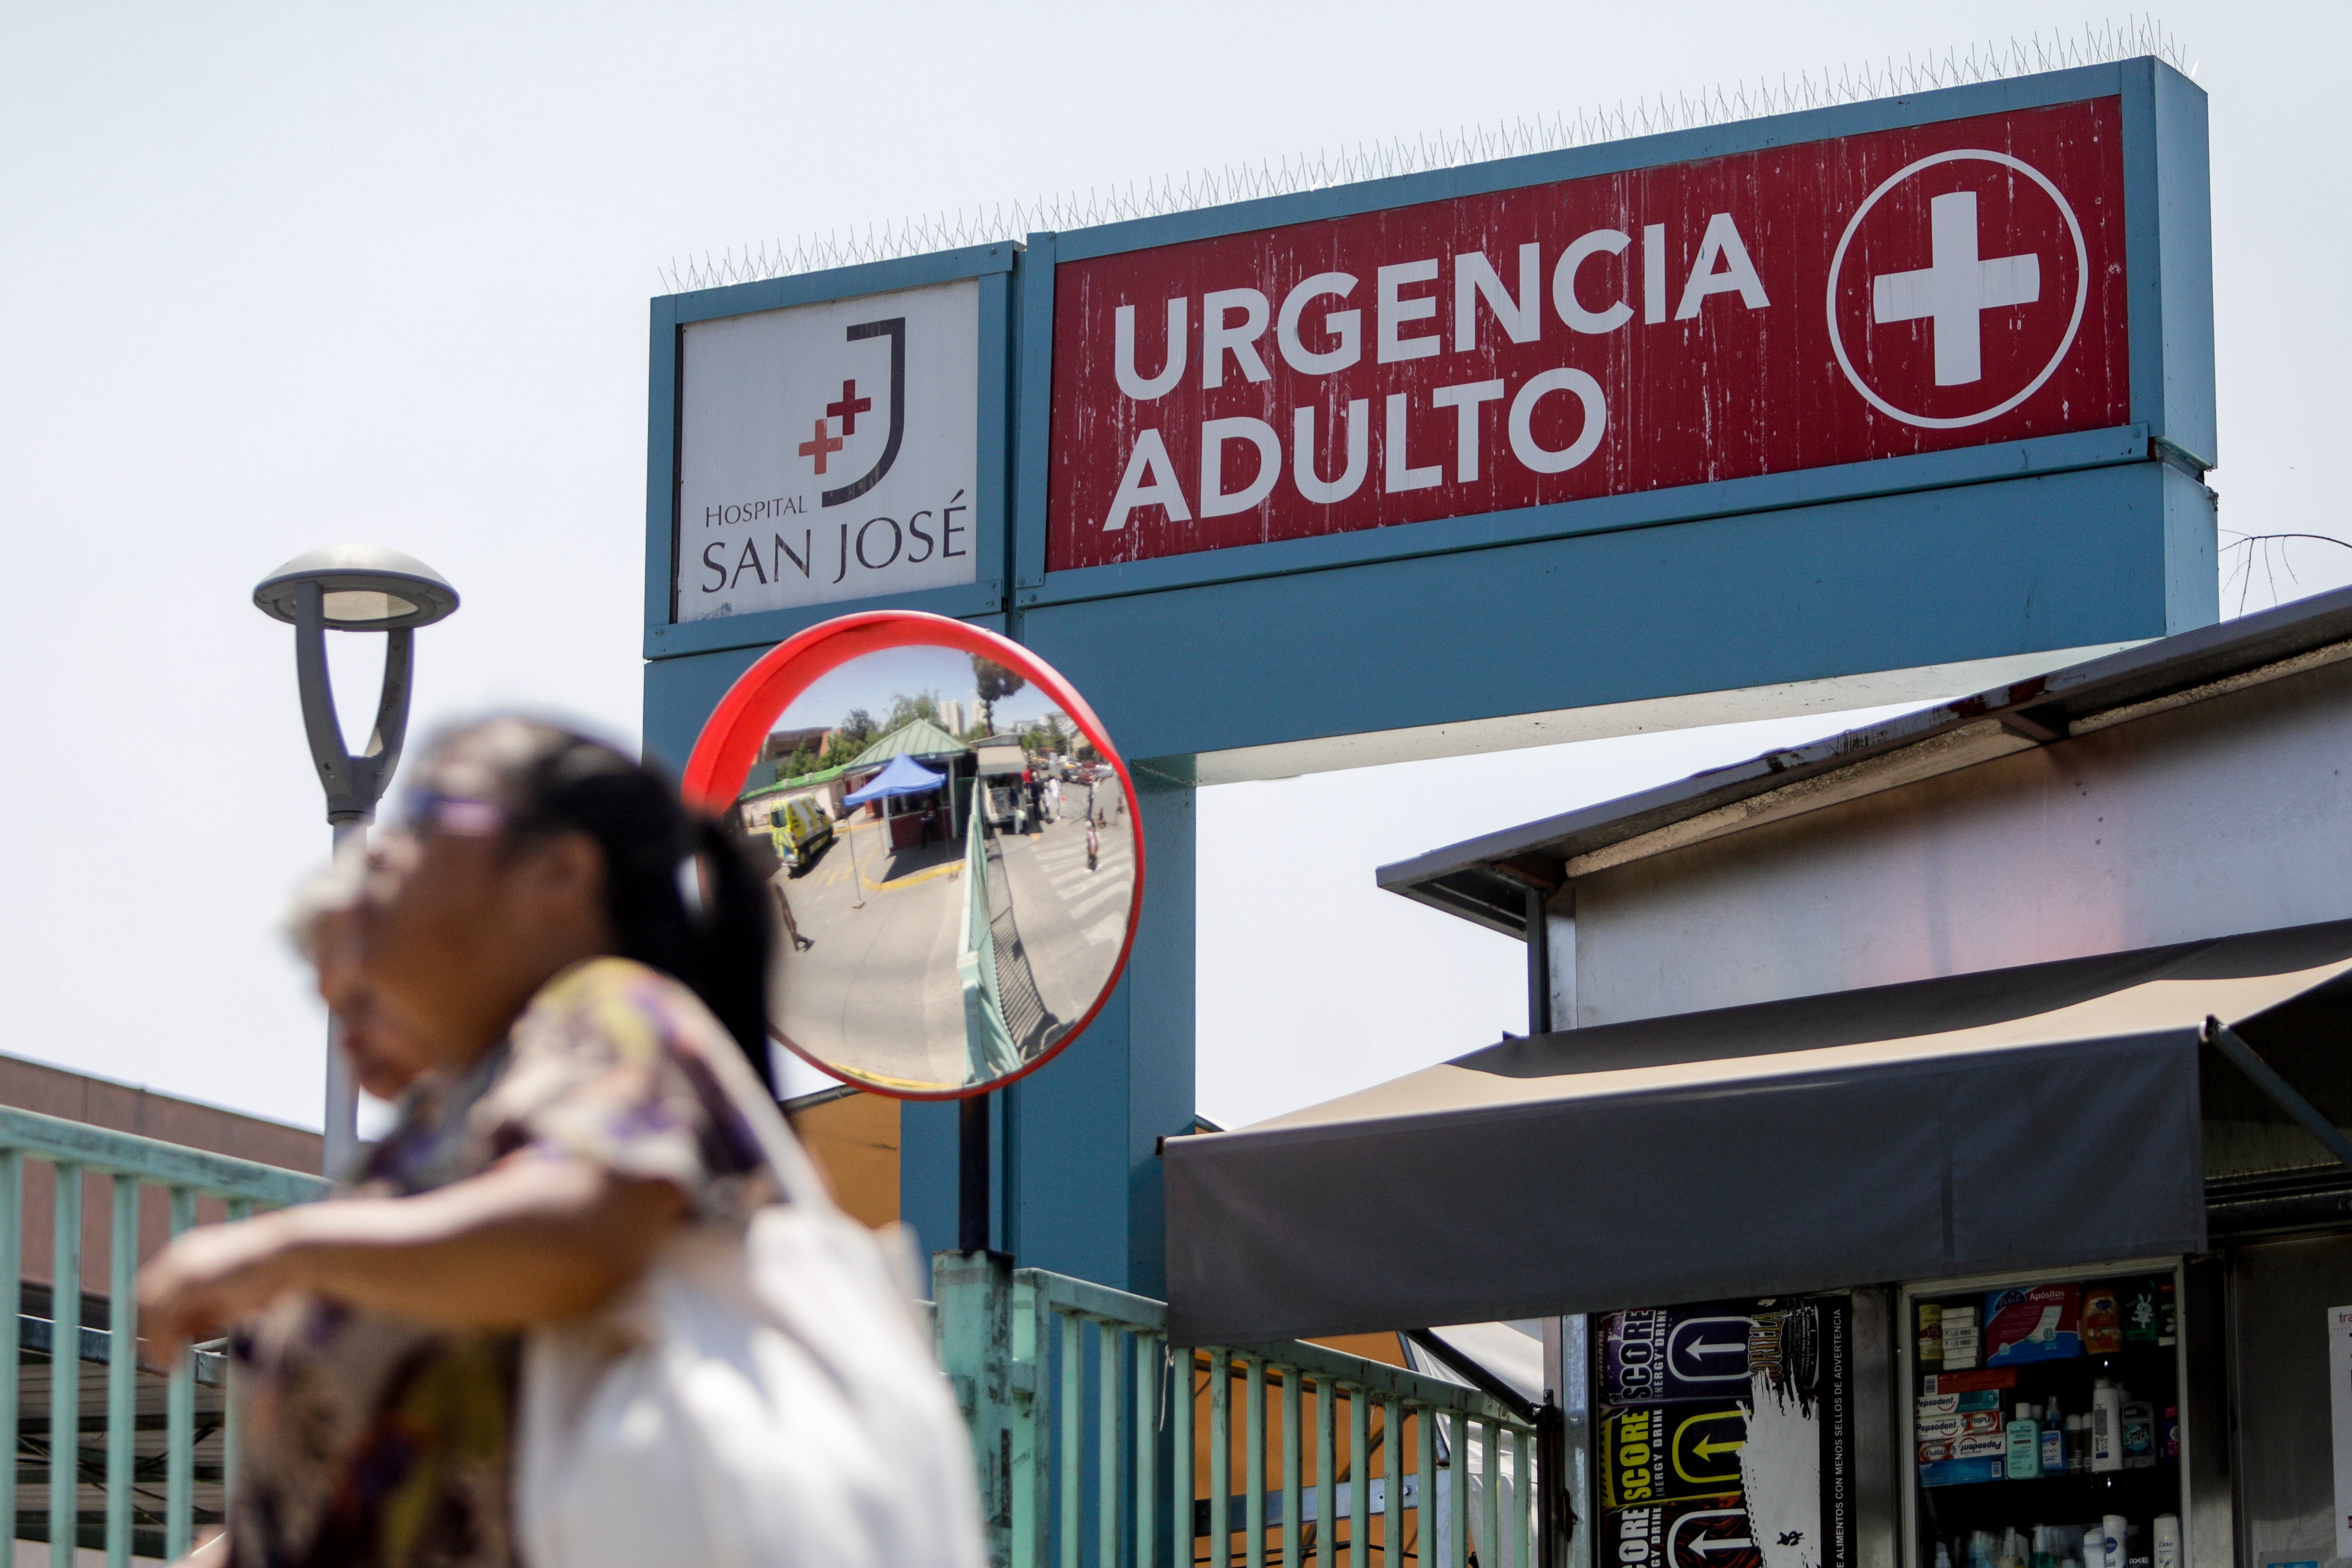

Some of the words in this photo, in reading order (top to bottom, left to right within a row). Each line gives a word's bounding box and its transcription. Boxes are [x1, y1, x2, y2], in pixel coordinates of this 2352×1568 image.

[1114, 212, 1771, 401] URGENCIA
[1103, 367, 1606, 531] ADULTO
[706, 495, 808, 527] HOSPITAL
[702, 529, 810, 593] SAN
[833, 489, 967, 584] JOSÉ
[2029, 1290, 2065, 1301] Apósitos
[1654, 1310, 1667, 1346] DRINK
[1833, 1309, 1842, 1379] ADVERTENCIA
[1619, 1310, 1656, 1401] SCORE
[1653, 1354, 1664, 1397] ENERGY
[1835, 1381, 1842, 1395] DE
[1916, 1397, 1954, 1408] Pepsodent
[1653, 1409, 1663, 1449] DRINK
[1917, 1422, 1956, 1433] Pepsodent
[1961, 1441, 2002, 1452] Pepsodent
[1620, 1410, 1652, 1501] SCORE
[1835, 1439, 1843, 1475] MENOS
[1653, 1454, 1665, 1497] ENERGY
[1835, 1478, 1843, 1499] CON
[1619, 1508, 1650, 1568] ORE
[1651, 1507, 1662, 1544] DRINK
[1836, 1502, 1844, 1559] ALIMENTOS
[2129, 1557, 2149, 1565] AXE
